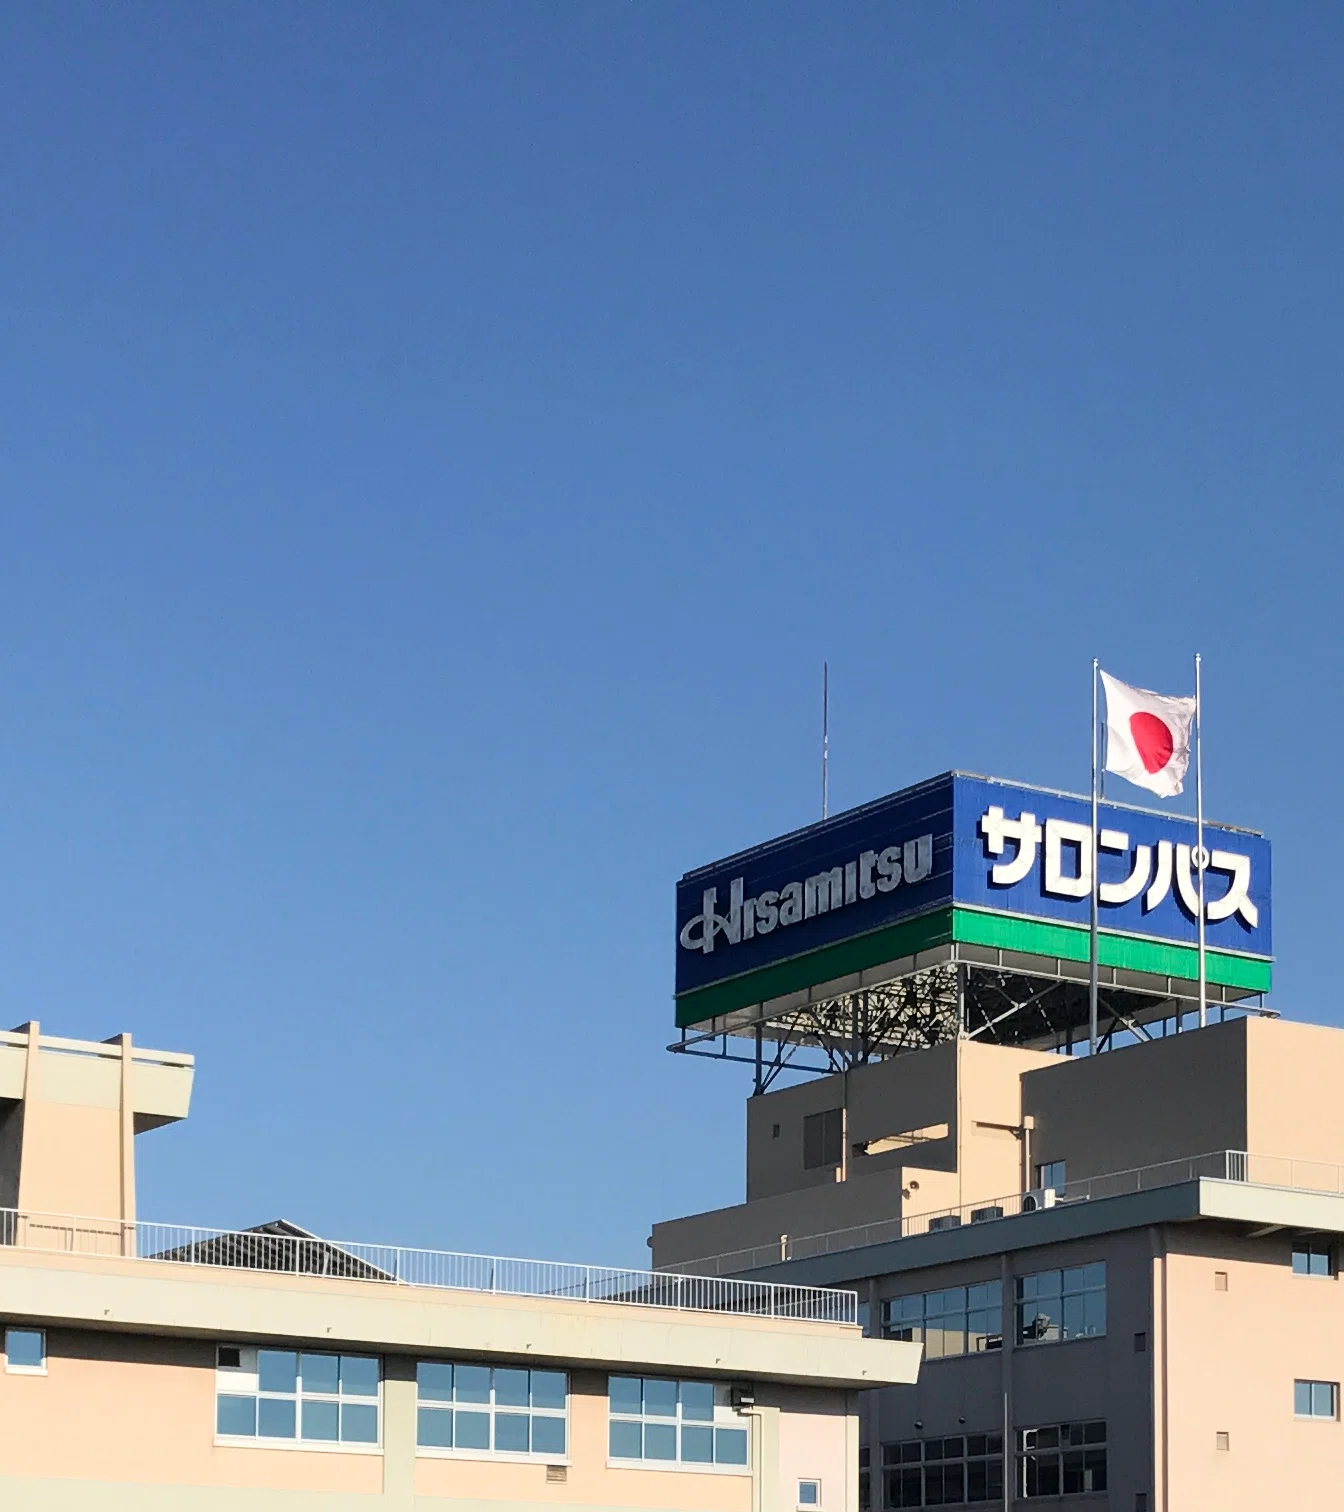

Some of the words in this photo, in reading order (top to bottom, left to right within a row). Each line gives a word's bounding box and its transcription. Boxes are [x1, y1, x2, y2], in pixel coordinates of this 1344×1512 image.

[680, 833, 933, 954] Hisamitsu
[981, 805, 1258, 928] サロンパス
